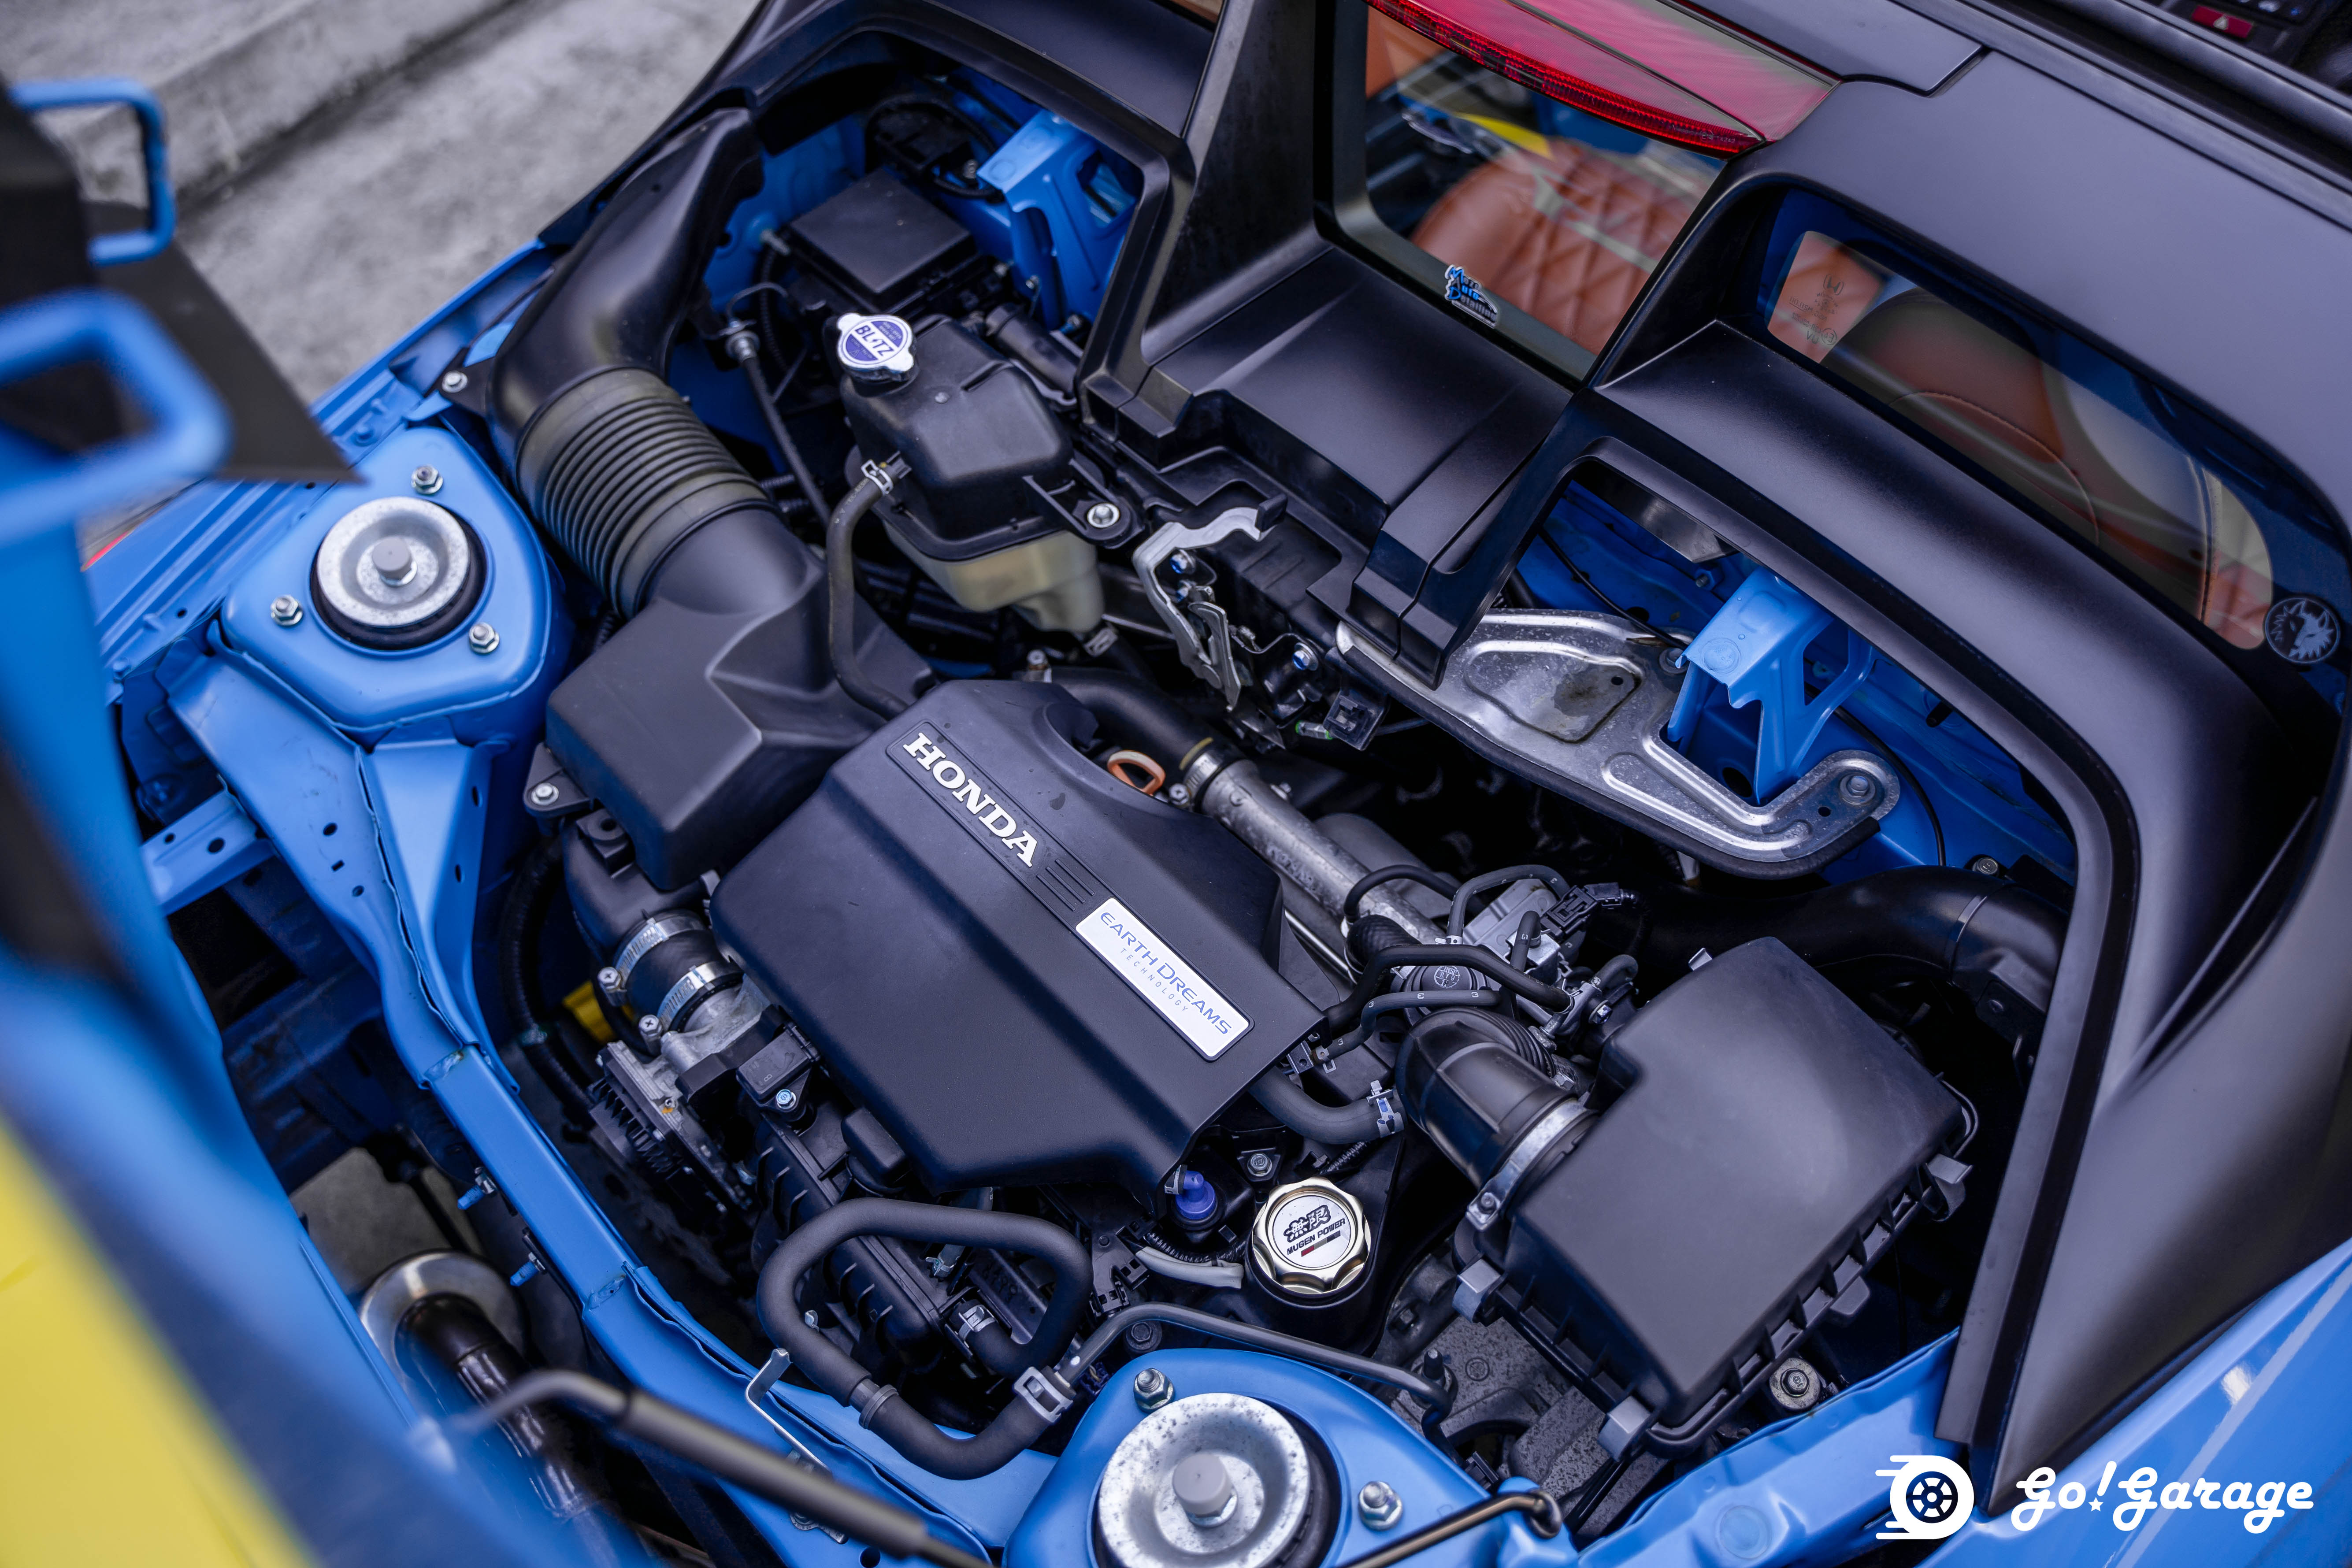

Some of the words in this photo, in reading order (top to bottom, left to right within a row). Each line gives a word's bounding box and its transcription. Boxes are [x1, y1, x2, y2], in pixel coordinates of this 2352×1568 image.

[855, 325, 894, 356] BLITZ
[903, 732, 1038, 867] HONDA
[1100, 912, 1158, 967] EARTH
[1156, 963, 1232, 1035] DREAMS
[1120, 948, 1188, 1012] TECHNOLOGY
[1287, 1234, 1316, 1255] MUGEN
[1317, 1218, 1346, 1238] POWER
